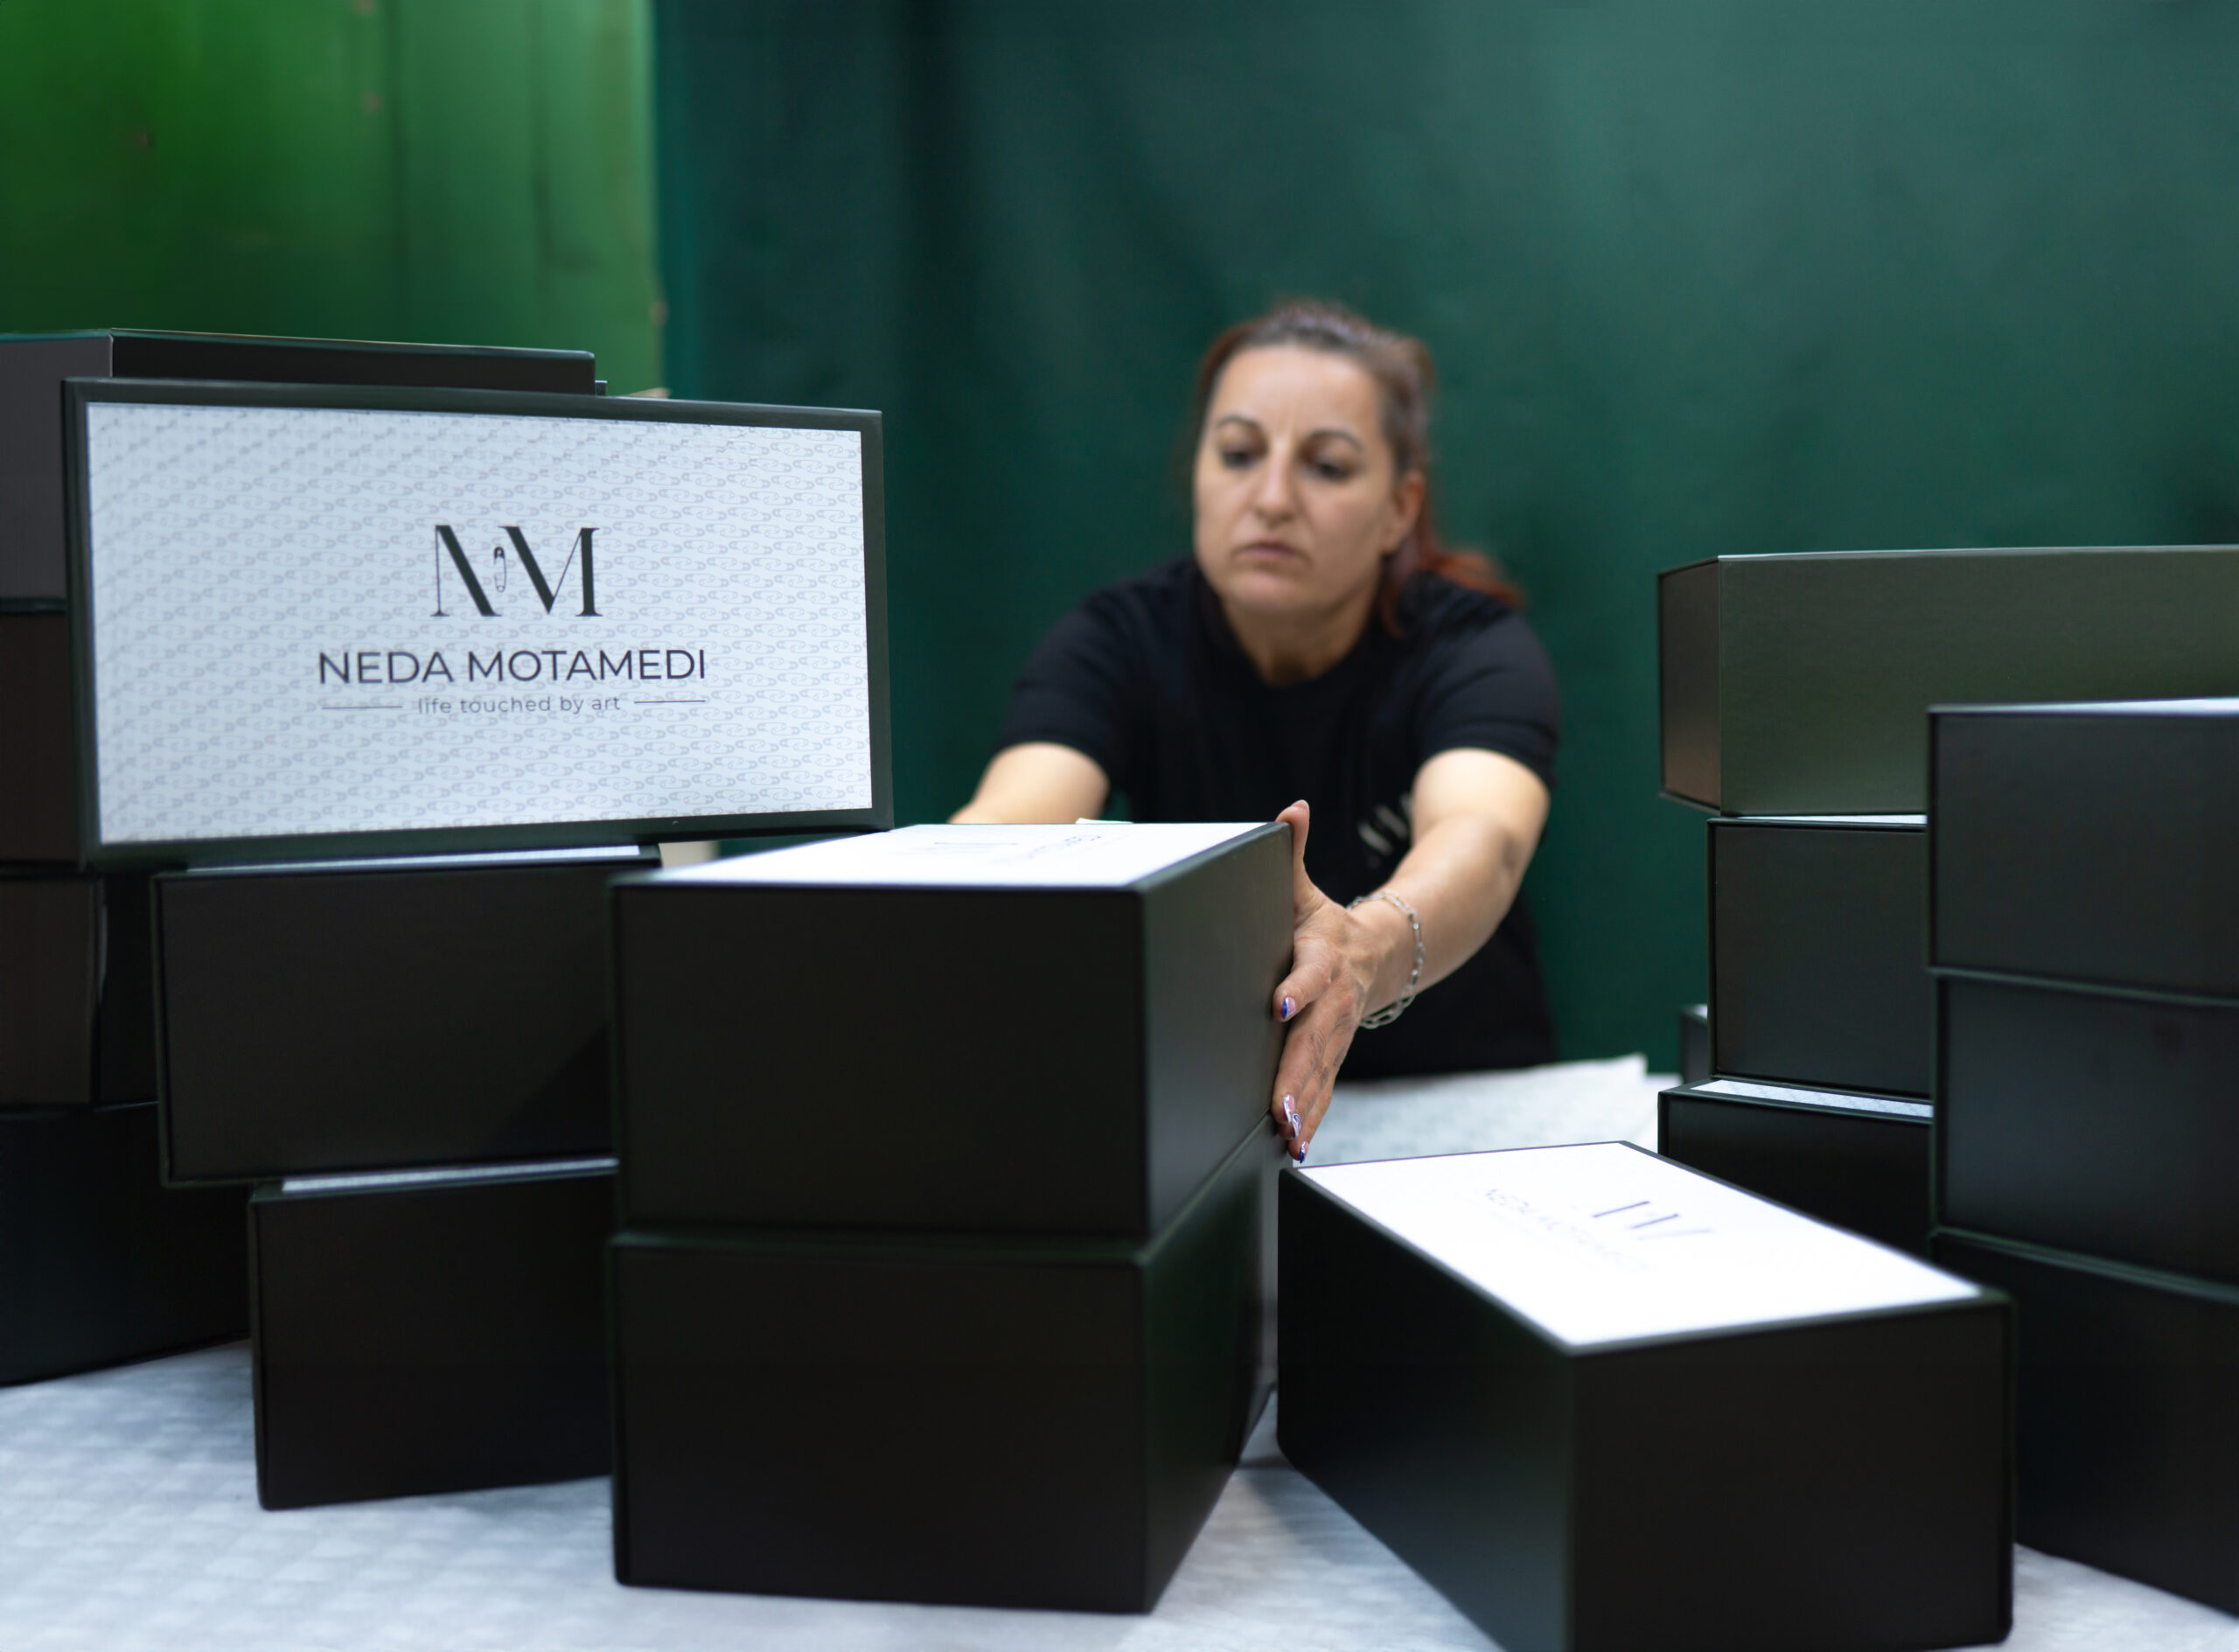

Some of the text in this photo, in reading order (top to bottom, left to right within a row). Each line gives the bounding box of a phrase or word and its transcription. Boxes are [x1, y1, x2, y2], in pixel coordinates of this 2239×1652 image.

[319, 649, 706, 685] NEDA MOTAMEDI
[418, 696, 621, 714] life touched by art
